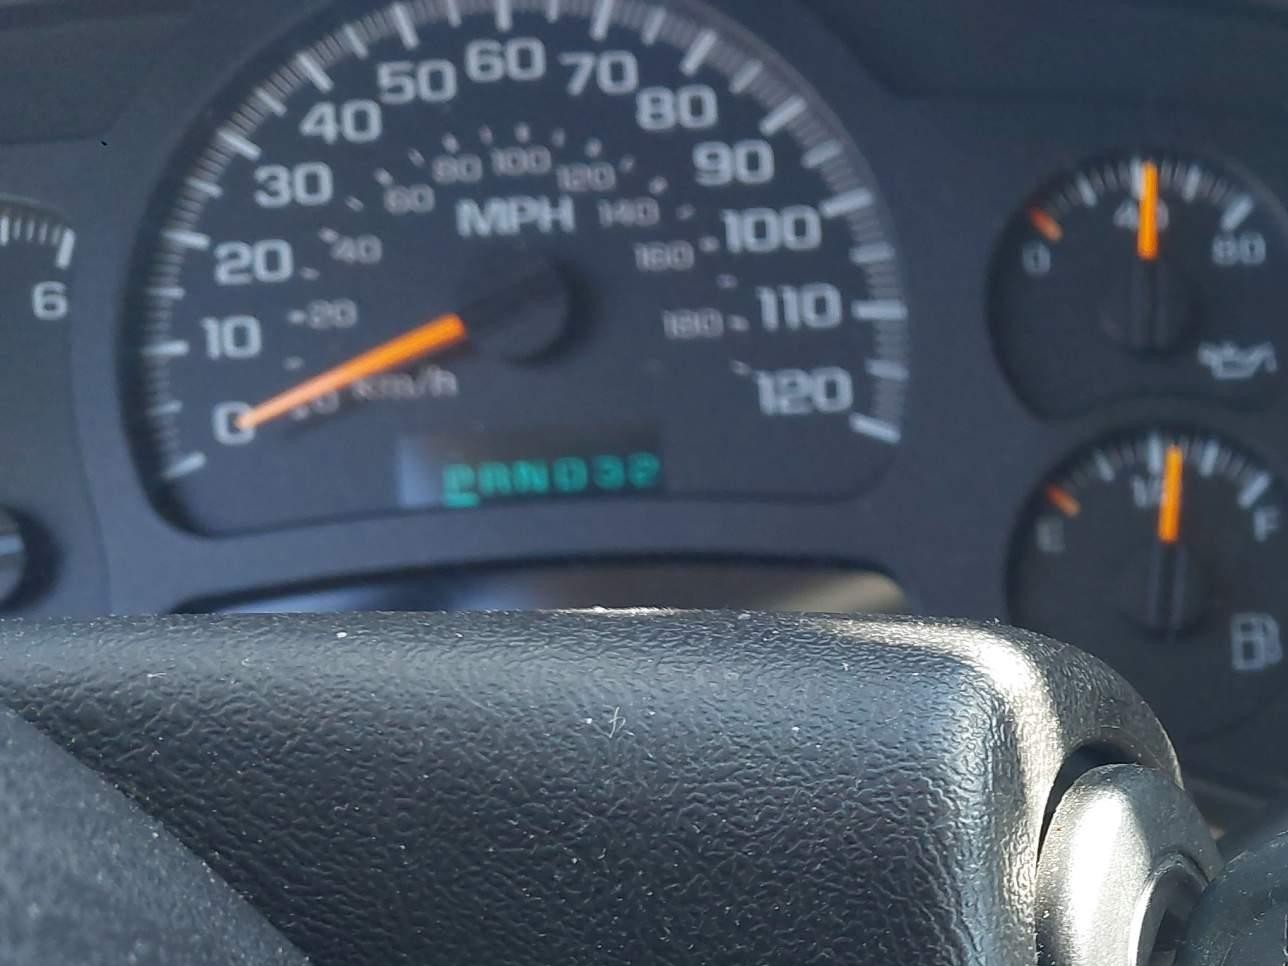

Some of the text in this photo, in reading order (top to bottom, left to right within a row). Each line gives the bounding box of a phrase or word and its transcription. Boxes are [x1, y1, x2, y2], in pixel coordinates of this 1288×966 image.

[378, 61, 457, 102] 50
[465, 38, 546, 82] 60
[559, 51, 638, 95] 70
[300, 101, 383, 143] 40
[636, 84, 718, 131] 80
[491, 146, 551, 175] 100
[693, 140, 775, 186] 90
[254, 163, 334, 207] 30
[456, 196, 575, 237] MPH
[721, 206, 822, 253] 100
[214, 240, 293, 285] 20
[331, 235, 382, 264] 40
[33, 281, 68, 320] 6
[757, 283, 843, 331] 110
[203, 315, 262, 359] 10
[758, 367, 853, 415] 120
[213, 402, 256, 445] 0
